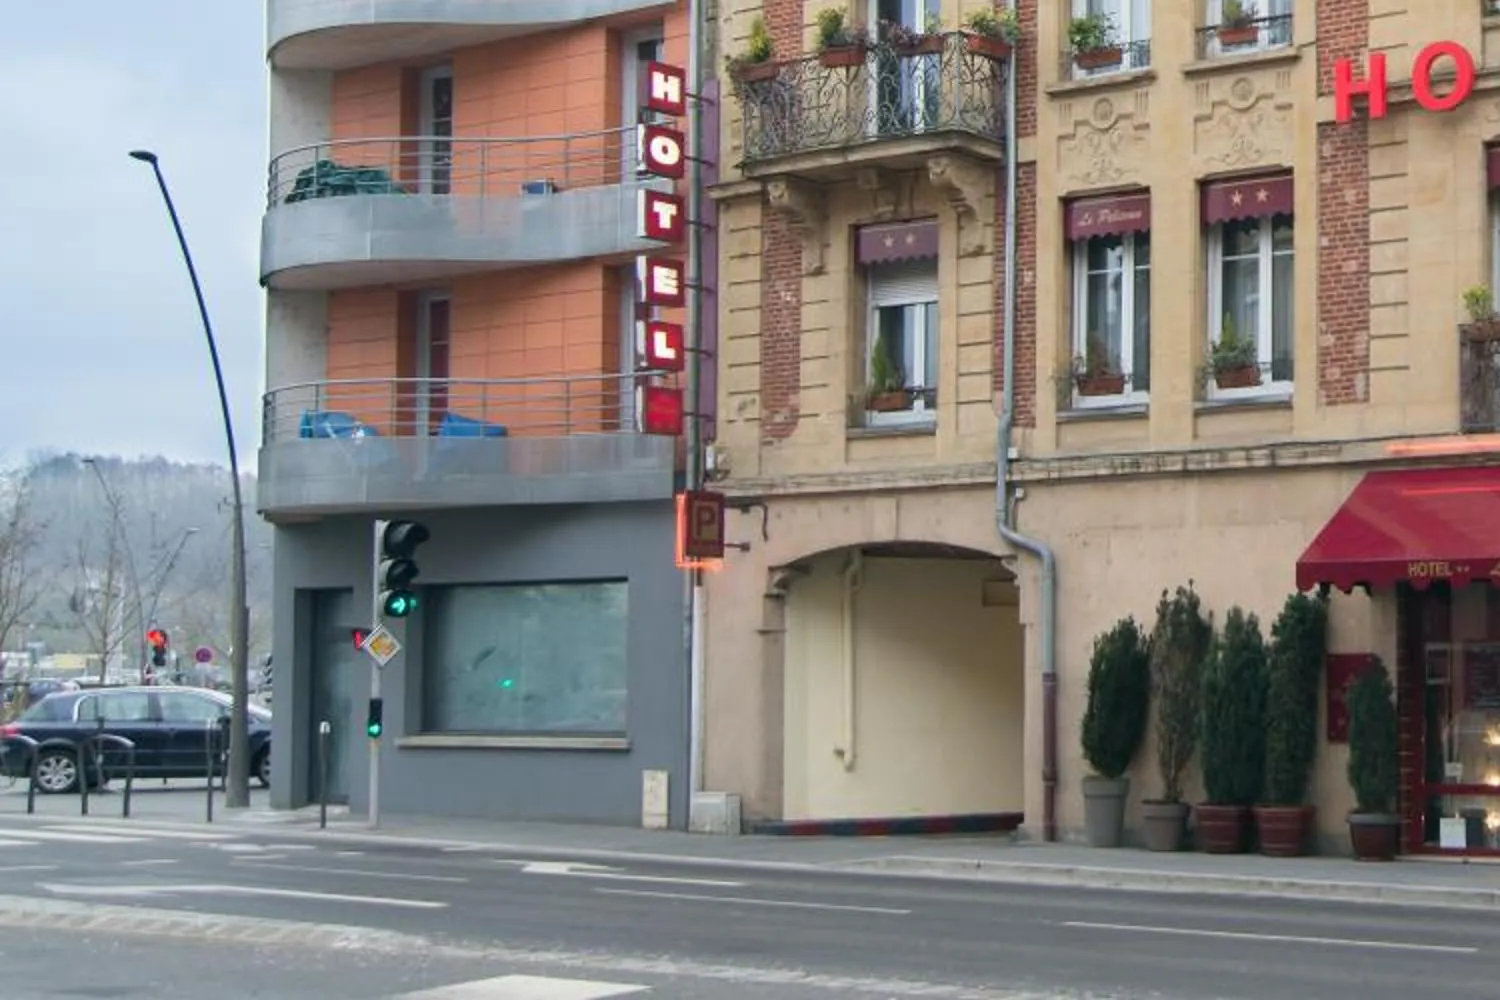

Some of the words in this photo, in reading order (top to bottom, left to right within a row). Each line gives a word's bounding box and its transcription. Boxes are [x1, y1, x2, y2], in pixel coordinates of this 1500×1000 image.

[650, 70, 682, 360] HOTEL
[697, 505, 716, 537] P
[1407, 561, 1453, 577] HOTEL
